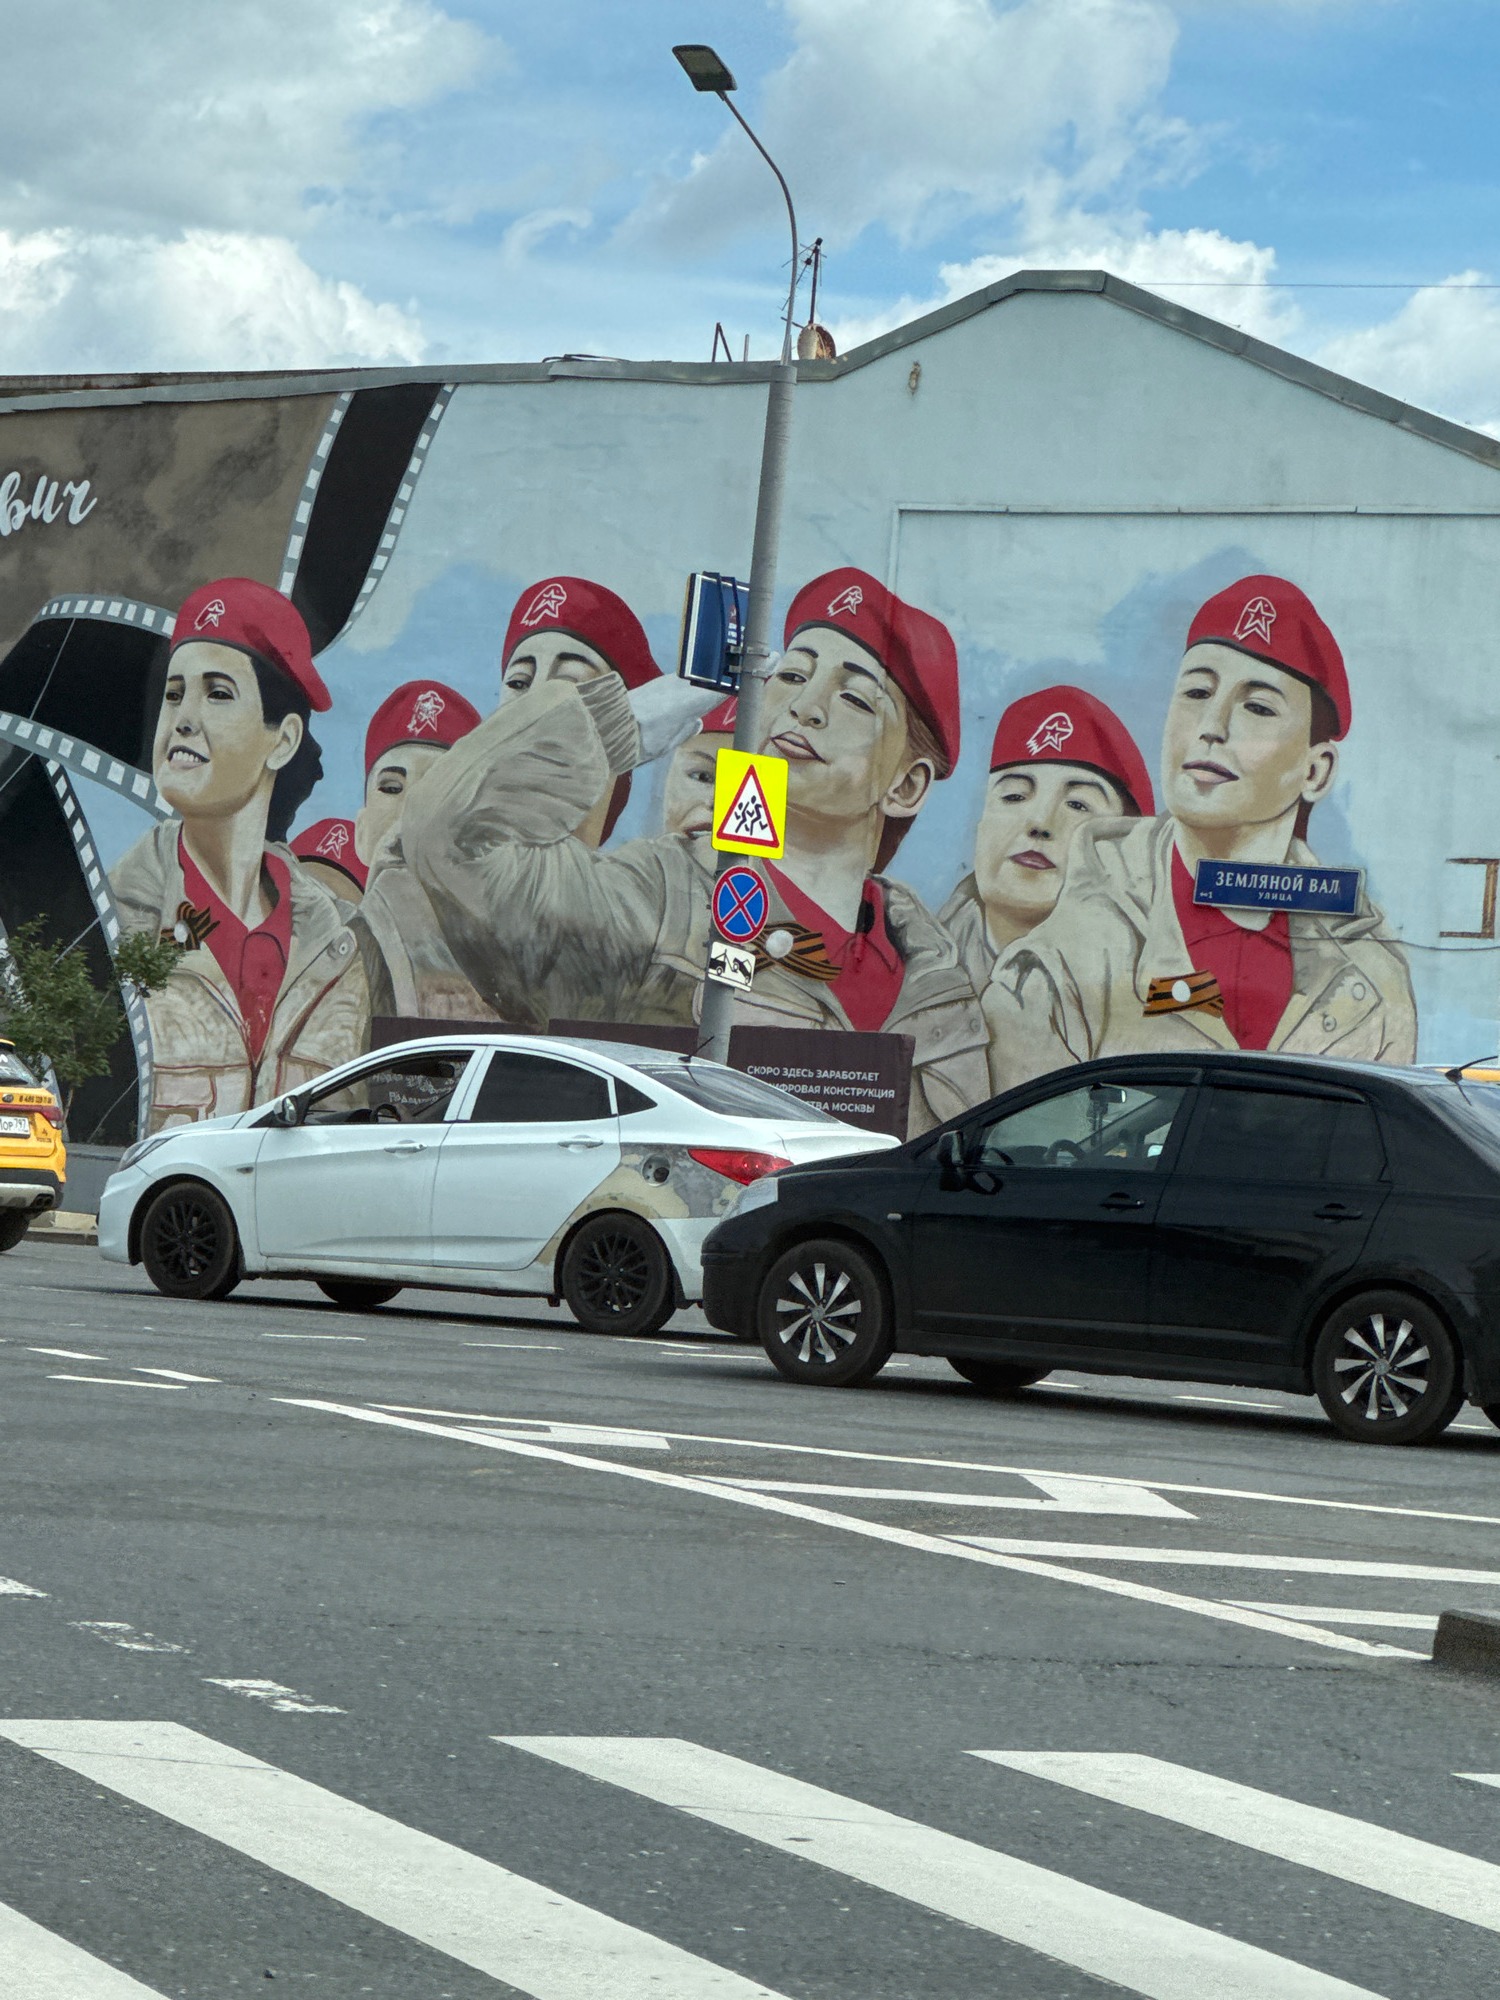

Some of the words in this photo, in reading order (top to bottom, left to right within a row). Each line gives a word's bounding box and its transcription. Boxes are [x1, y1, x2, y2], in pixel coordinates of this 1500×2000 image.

[1215, 870, 1303, 892] ЗЕМЛЯНОЙ
[1308, 878, 1340, 894] ВАЛ
[1258, 891, 1292, 901] УЛИЦА
[747, 1065, 780, 1076] СКОРО
[782, 1067, 814, 1078] ЗДЕСЬ
[815, 1069, 880, 1081] ЗАРАБОТАЕТ
[823, 1086, 895, 1099] КОНСТРУКЦИЯ
[832, 1102, 875, 1113] МОСКВЫ
